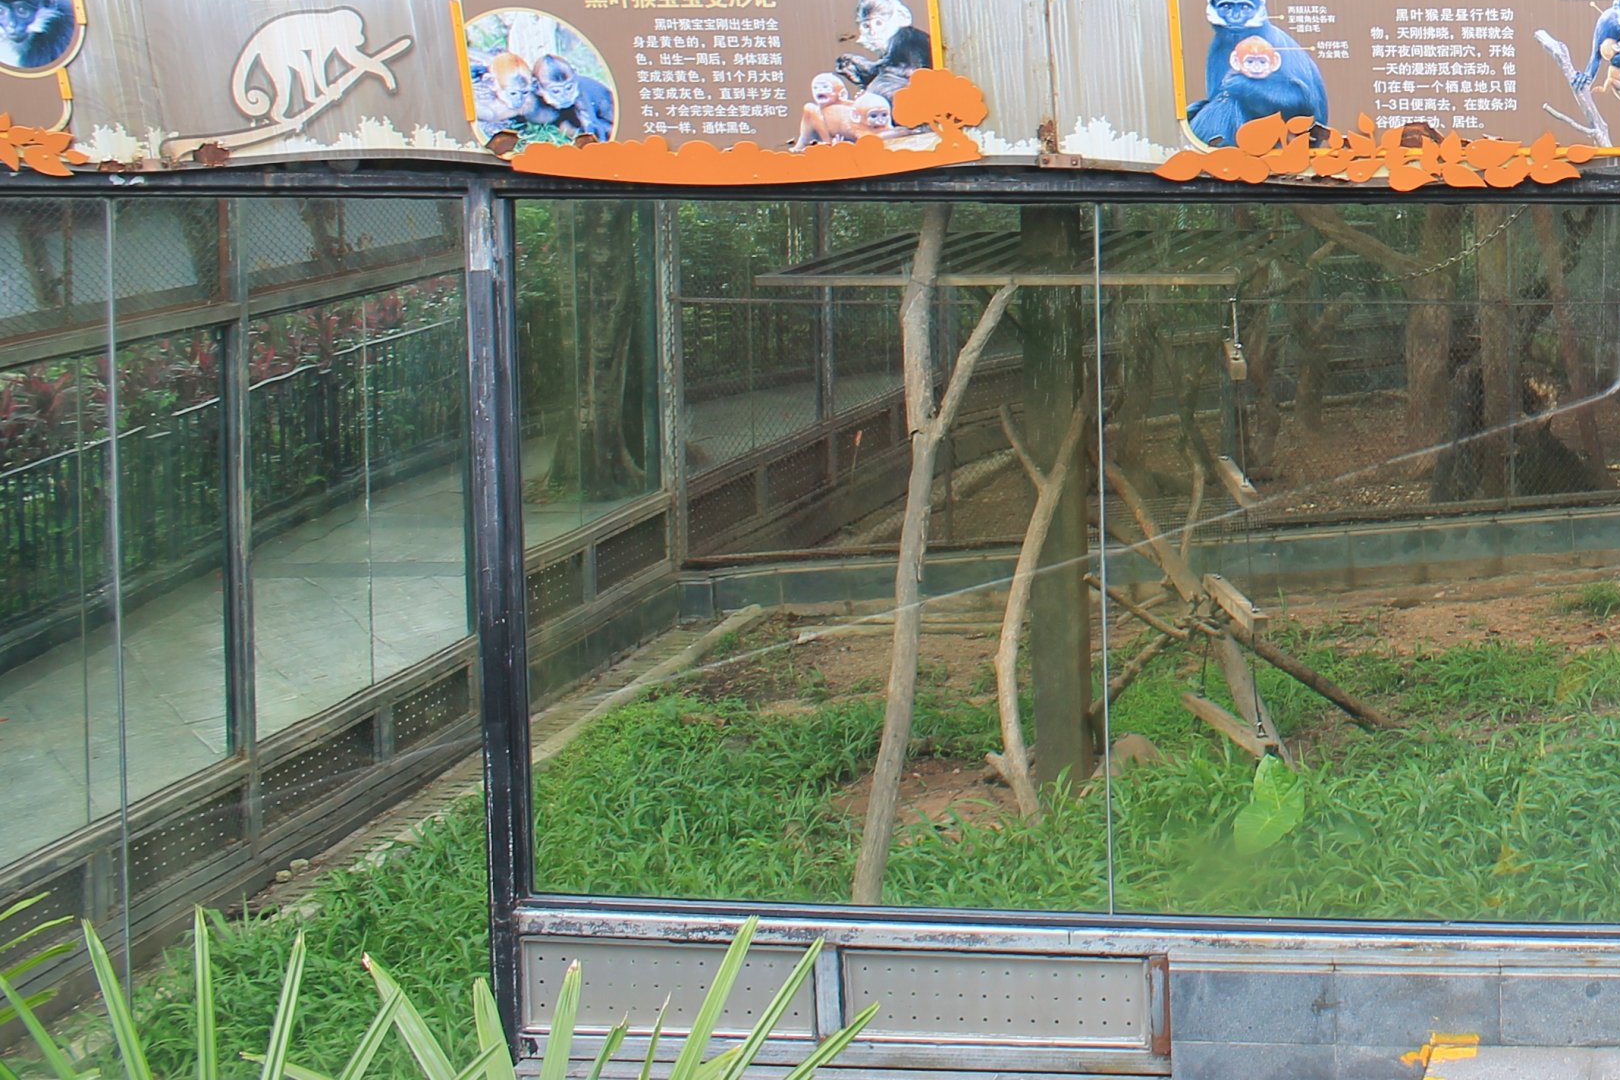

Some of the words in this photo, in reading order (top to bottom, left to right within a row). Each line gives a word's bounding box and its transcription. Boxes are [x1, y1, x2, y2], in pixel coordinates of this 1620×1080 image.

[1395, 8, 1514, 22] 黑叶猴是昼行性动
[654, 18, 779, 31] 黑叶猴宝宝刚出生时全
[1370, 26, 1515, 40] 物，天刚拂晓，猴群就会
[632, 35, 781, 49] 身是黄色的，尾巴为灰褐
[1371, 44, 1516, 58] 离开夜间歇宿洞穴，开始
[634, 52, 783, 66] 色，出生一周后，身体逐渐
[1372, 62, 1517, 76] 一天的漫游觅食活动。他
[637, 70, 784, 84] 变成淡黄色，到1个月大时
[639, 87, 787, 101] 会变成灰色，直到半岁左
[1373, 80, 1517, 94] 们在每一个栖息地只留
[640, 104, 788, 118] 右，才会完完全全变成和它
[643, 121, 758, 135] 父母一样，通体黑色。
